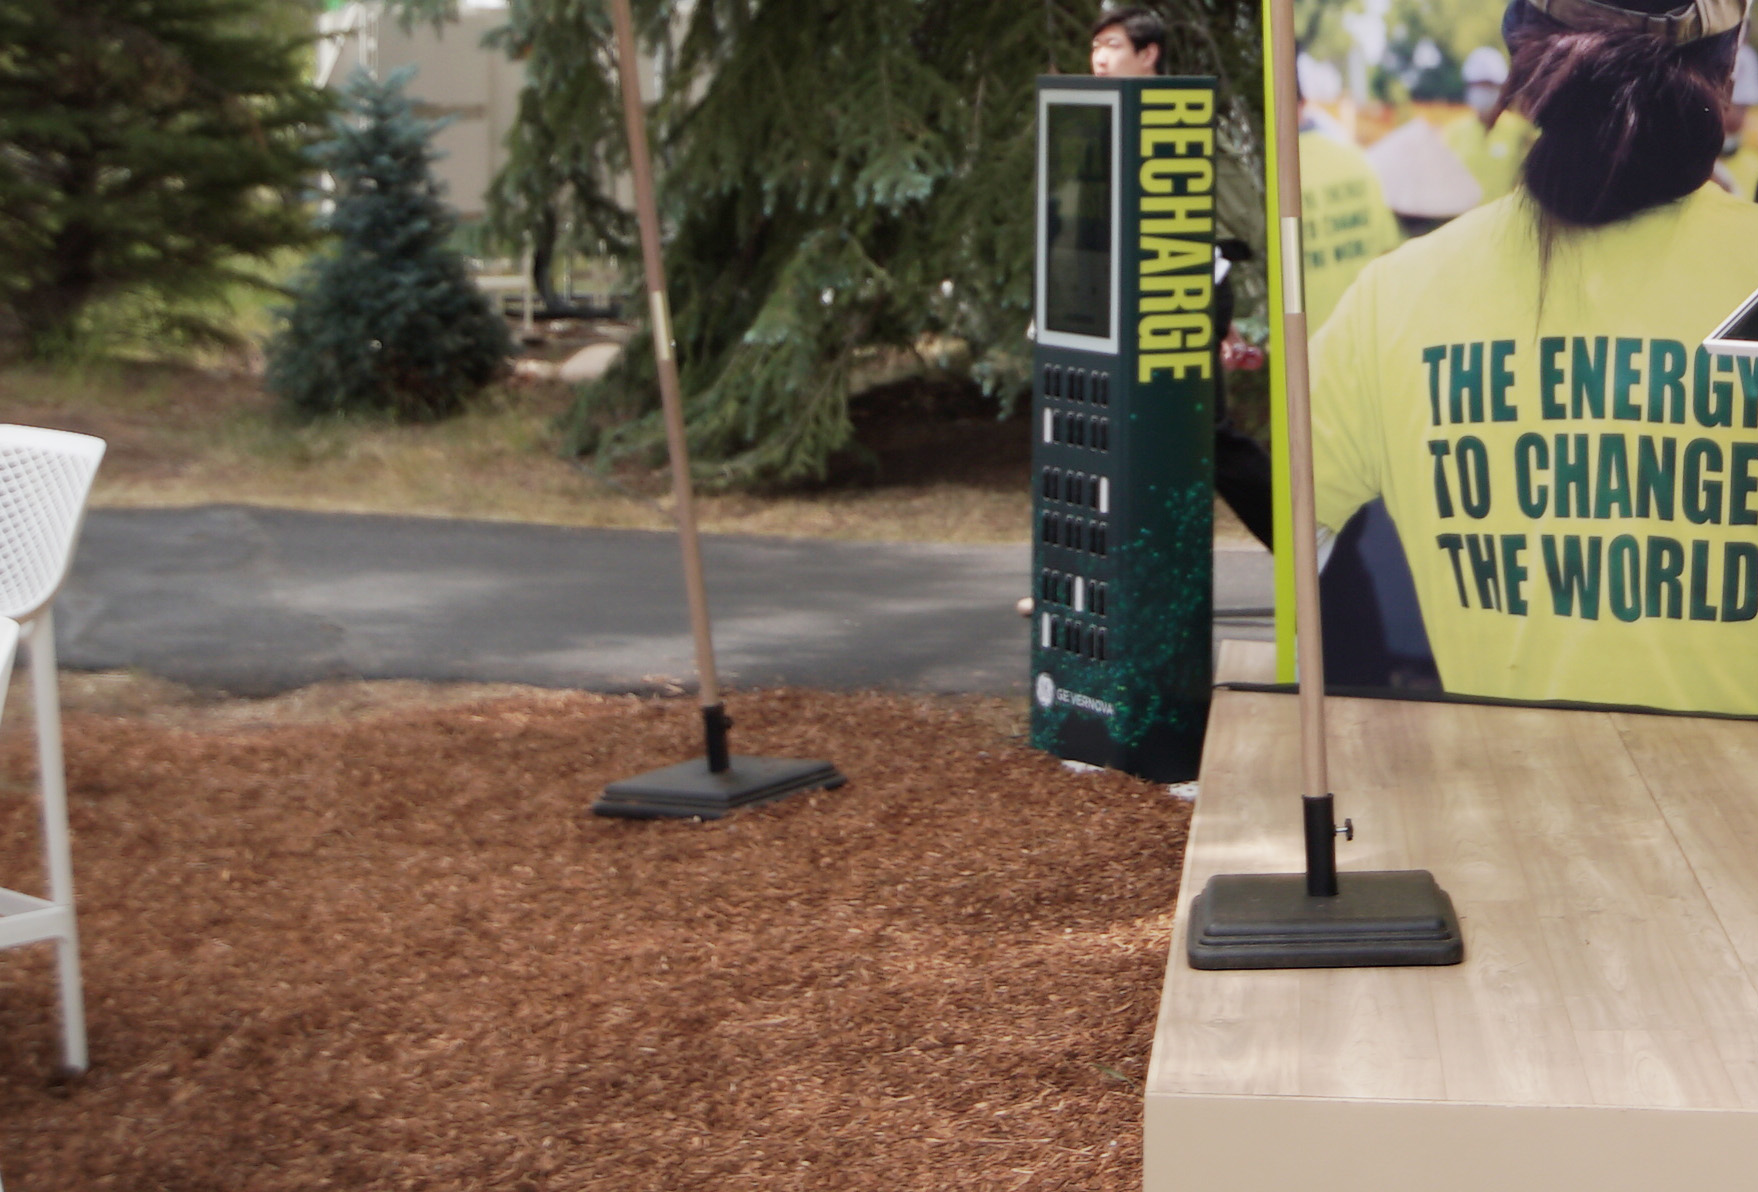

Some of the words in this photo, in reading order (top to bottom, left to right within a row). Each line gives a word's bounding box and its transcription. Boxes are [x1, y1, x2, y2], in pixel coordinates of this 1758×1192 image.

[1138, 89, 1214, 383] RECHARGE
[1422, 339, 1518, 426] THE
[1428, 435, 1491, 519] TO
[1436, 533, 1528, 616] THE
[1056, 688, 1070, 703] GE
[1072, 693, 1114, 715] VERNOVA
